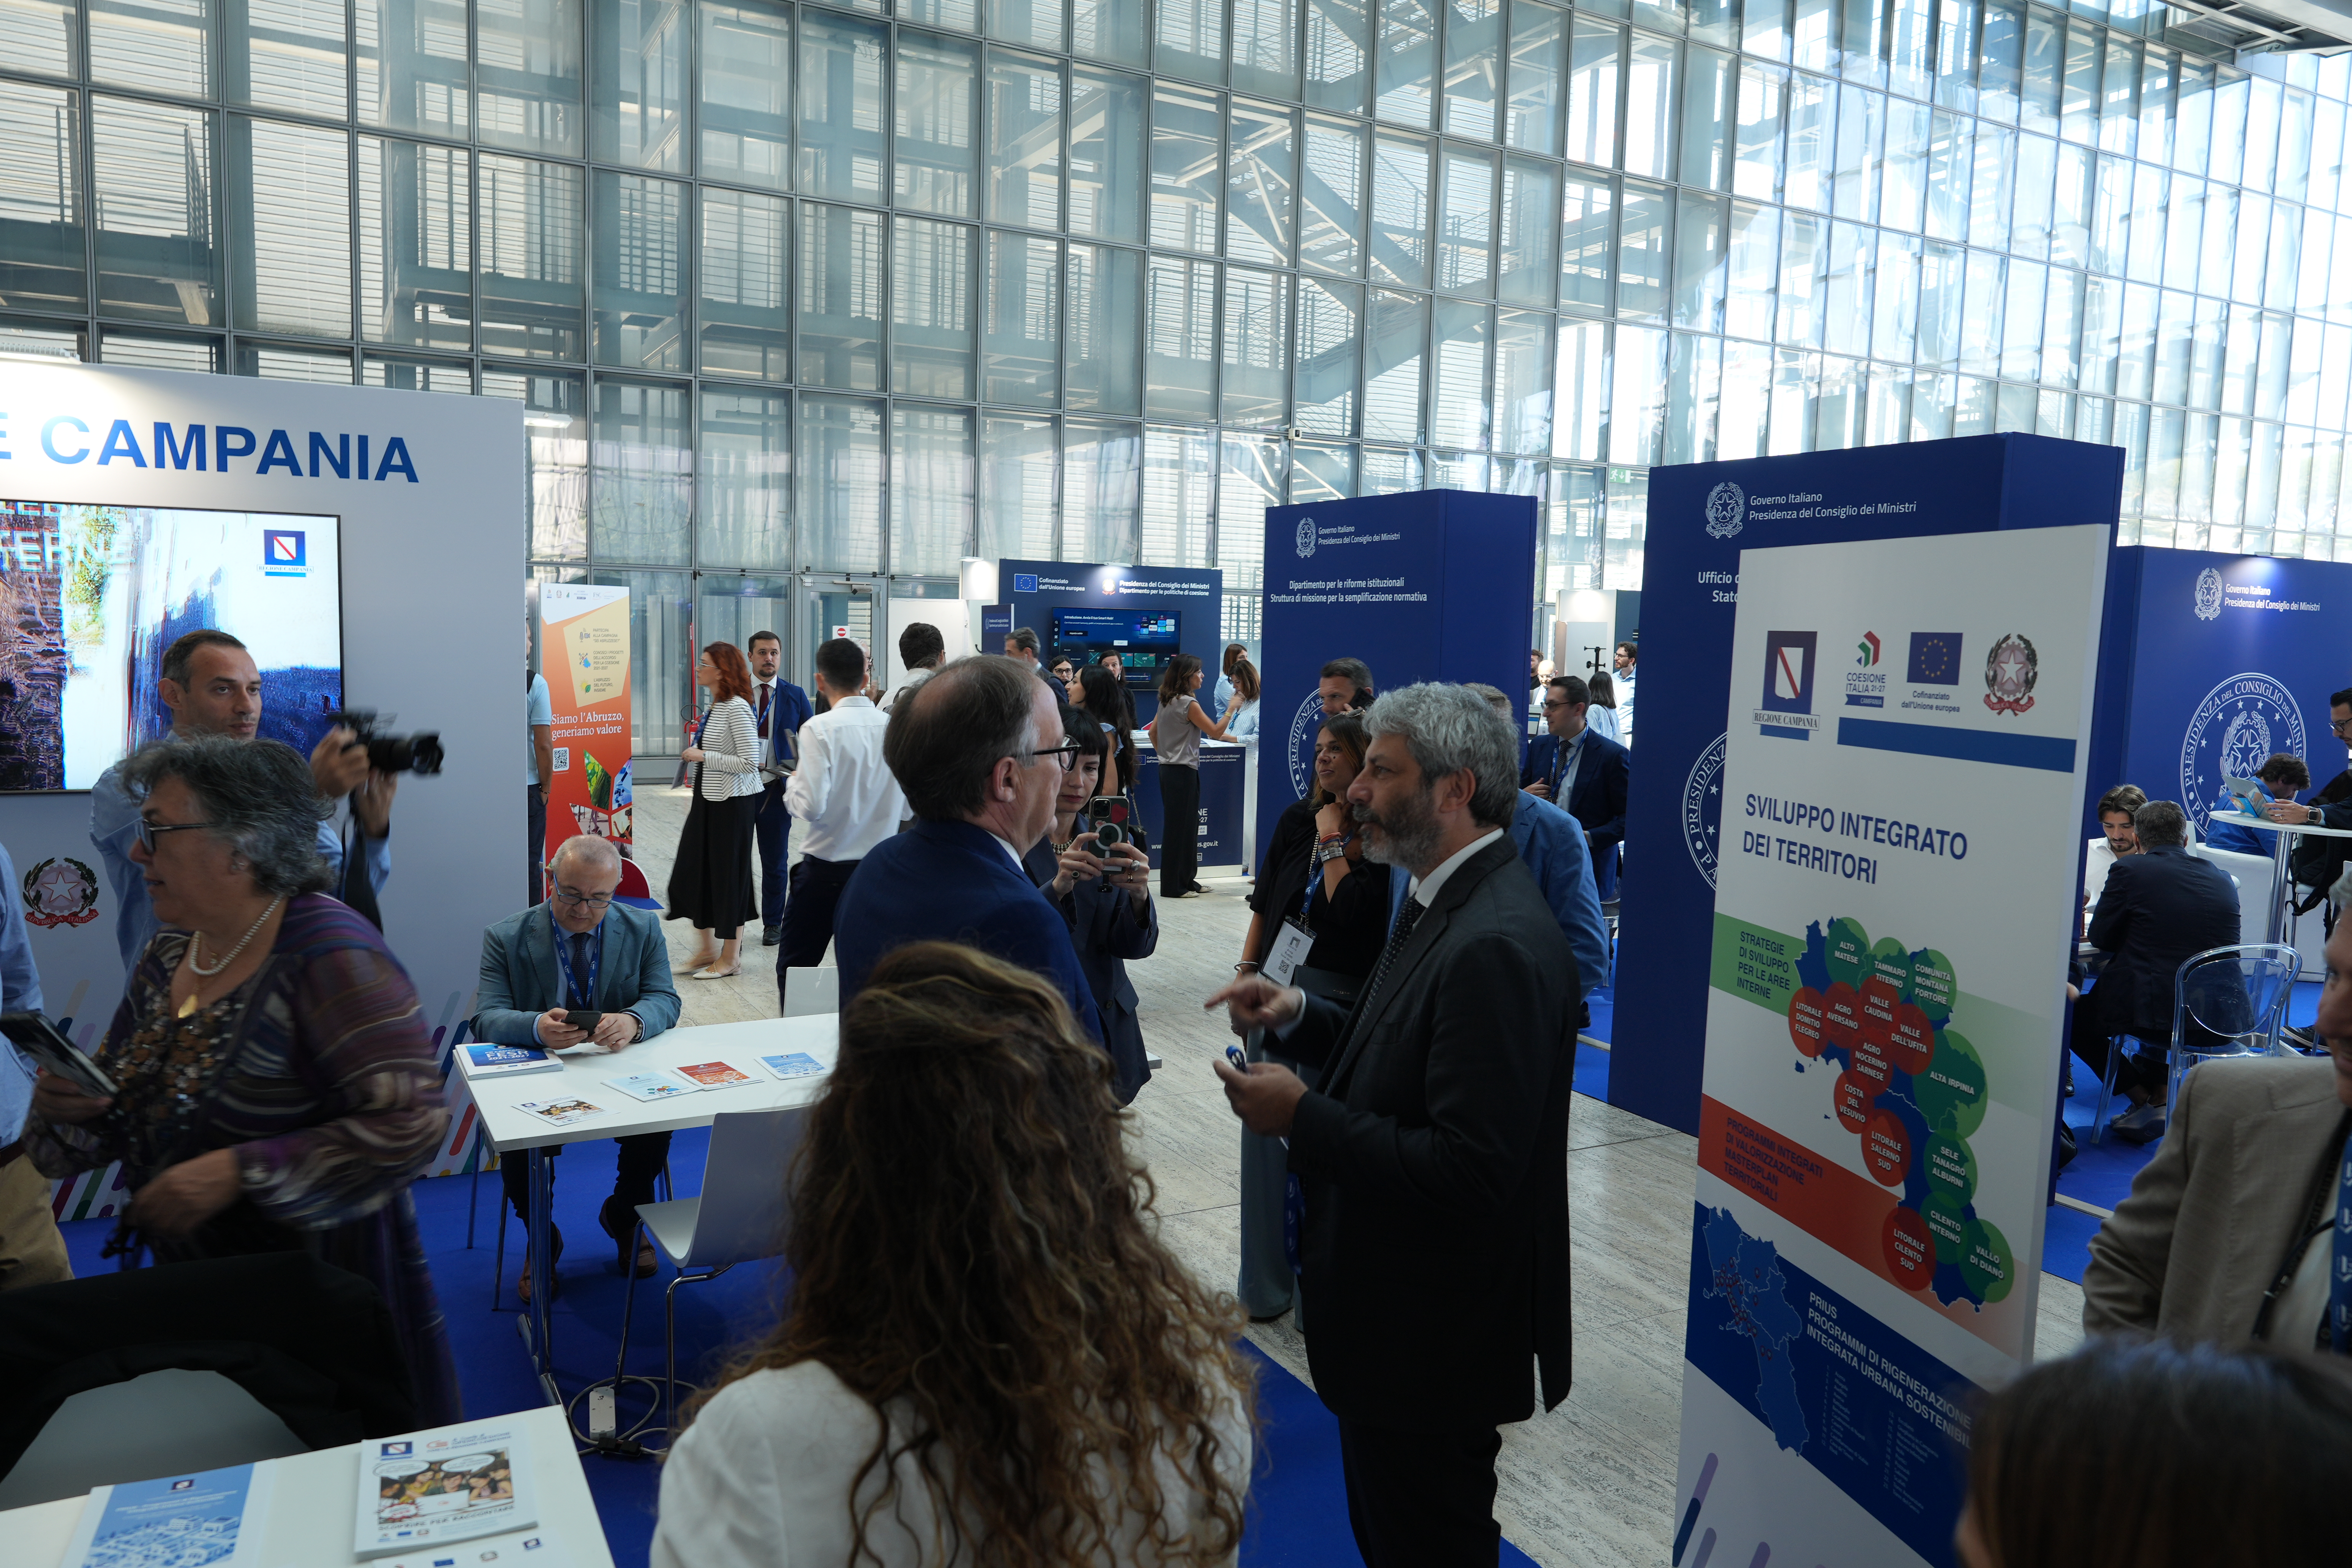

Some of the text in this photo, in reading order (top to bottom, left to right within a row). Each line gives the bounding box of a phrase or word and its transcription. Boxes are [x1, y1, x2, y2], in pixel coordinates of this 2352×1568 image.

[40, 415, 419, 483] CAMPANIA
[1750, 493, 1822, 505] Governo Italiano
[1749, 501, 1917, 520] Presidenza del Consiglio dei Ministri
[1318, 537, 1342, 545] Presidenza
[1351, 534, 1372, 544] Consiglio
[1381, 532, 1400, 541] Ministri
[1289, 577, 1404, 591] Dipartimento per le riforme istituzionali
[1698, 571, 1732, 584] Ufficio
[1270, 592, 1427, 604] Struttura di missione per la semplificazione normativa
[2226, 583, 2271, 596] Governo Italiano
[2224, 597, 2320, 612] Presidenza del Consiglio dei Ministri
[1847, 672, 1886, 683] COESIONE
[1846, 683, 1870, 693] ITALIA
[1913, 691, 1950, 700] Cofinanziato
[1901, 701, 1960, 713] dall'Unione europea
[552, 711, 624, 724] Siamo l'Abruzzo,
[1755, 713, 1818, 728] REGIONE CAMPANIA
[552, 724, 622, 741] generiamo valore
[1292, 700, 1316, 770] PRESIDENZA
[2185, 681, 2302, 787] PRESIDENZA DEL CONSIGLIO DEI MINIS
[1689, 743, 1726, 835] PRESIDENZ
[1745, 793, 1968, 860] SVILUPPO INTEGRATO
[1743, 831, 1877, 884] DEI TERRITORI
[25, 912, 97, 925] REPVBBLICA ITALIANA
[1740, 931, 1784, 956] STRATEGIE
[1840, 941, 1855, 952] ALTO
[1739, 946, 1789, 973] DI SVILUPPO
[1834, 950, 1858, 964] MATESE
[1738, 961, 1790, 990] PER LE AREE
[1875, 961, 1906, 978] TAMMARO
[1737, 977, 1771, 999] INTERNE
[1875, 973, 1903, 988] TITERNO
[1915, 975, 1949, 993] MONTANA
[1870, 995, 1889, 1008] VALLE
[1915, 988, 1947, 1005] FORTORE
[1796, 1001, 1822, 1018] LITORALE
[1835, 1003, 1852, 1015] AGRO
[1864, 1005, 1893, 1022] CAUDINA
[1796, 1013, 1820, 1028] DOMITIO
[1827, 1012, 1858, 1029] AVERSANO
[1795, 1024, 1820, 1040] FLEGREO
[1900, 1024, 1920, 1038] VALLE
[1863, 1042, 1881, 1056] AGRO
[1891, 1033, 1927, 1054] DELL'UFITA
[1855, 1051, 1887, 1070] NOCERINO
[1856, 1064, 1884, 1081] SARNESE
[1845, 1084, 1864, 1099] COSTA
[1930, 1071, 1975, 1095] ALTA IRPINIA
[1847, 1097, 1859, 1108] DEL
[1840, 1105, 1866, 1123] VESUVIO
[1727, 1117, 1823, 1178] PROGRAMMI INTEGRATI
[1871, 1131, 1902, 1152] LITORALE
[1726, 1132, 1804, 1185] DI VALORIZZAZIONE
[1871, 1143, 1900, 1163] SALERNO
[1940, 1146, 1959, 1161] SELE
[1725, 1147, 1778, 1187] MASTERPLAN
[1878, 1158, 1891, 1171] SUD
[1932, 1154, 1966, 1176] TANAGRO
[1724, 1161, 1778, 1202] TERRITORIALI
[1932, 1167, 1963, 1189] ALBURNI
[1930, 1210, 1961, 1232] CILENTO
[1894, 1228, 1925, 1252] LITORALE
[1929, 1221, 1961, 1244] INTERNO
[1894, 1242, 1922, 1263] CILENTO
[1976, 1245, 2000, 1264] VALLO
[1900, 1257, 1915, 1271] SUD
[1970, 1255, 2004, 1279] DI DIANO
[1810, 1291, 1837, 1319] PRIUS
[1808, 1307, 1867, 1357] PROGRAMMI
[1868, 1349, 1879, 1366] DI
[1881, 1358, 1971, 1430] RIGENERAZIONE
[1807, 1323, 1859, 1370] INTEGRATA
[1861, 1361, 1904, 1402] URBANA
[1906, 1394, 1971, 1450] SOSTENIBIL
